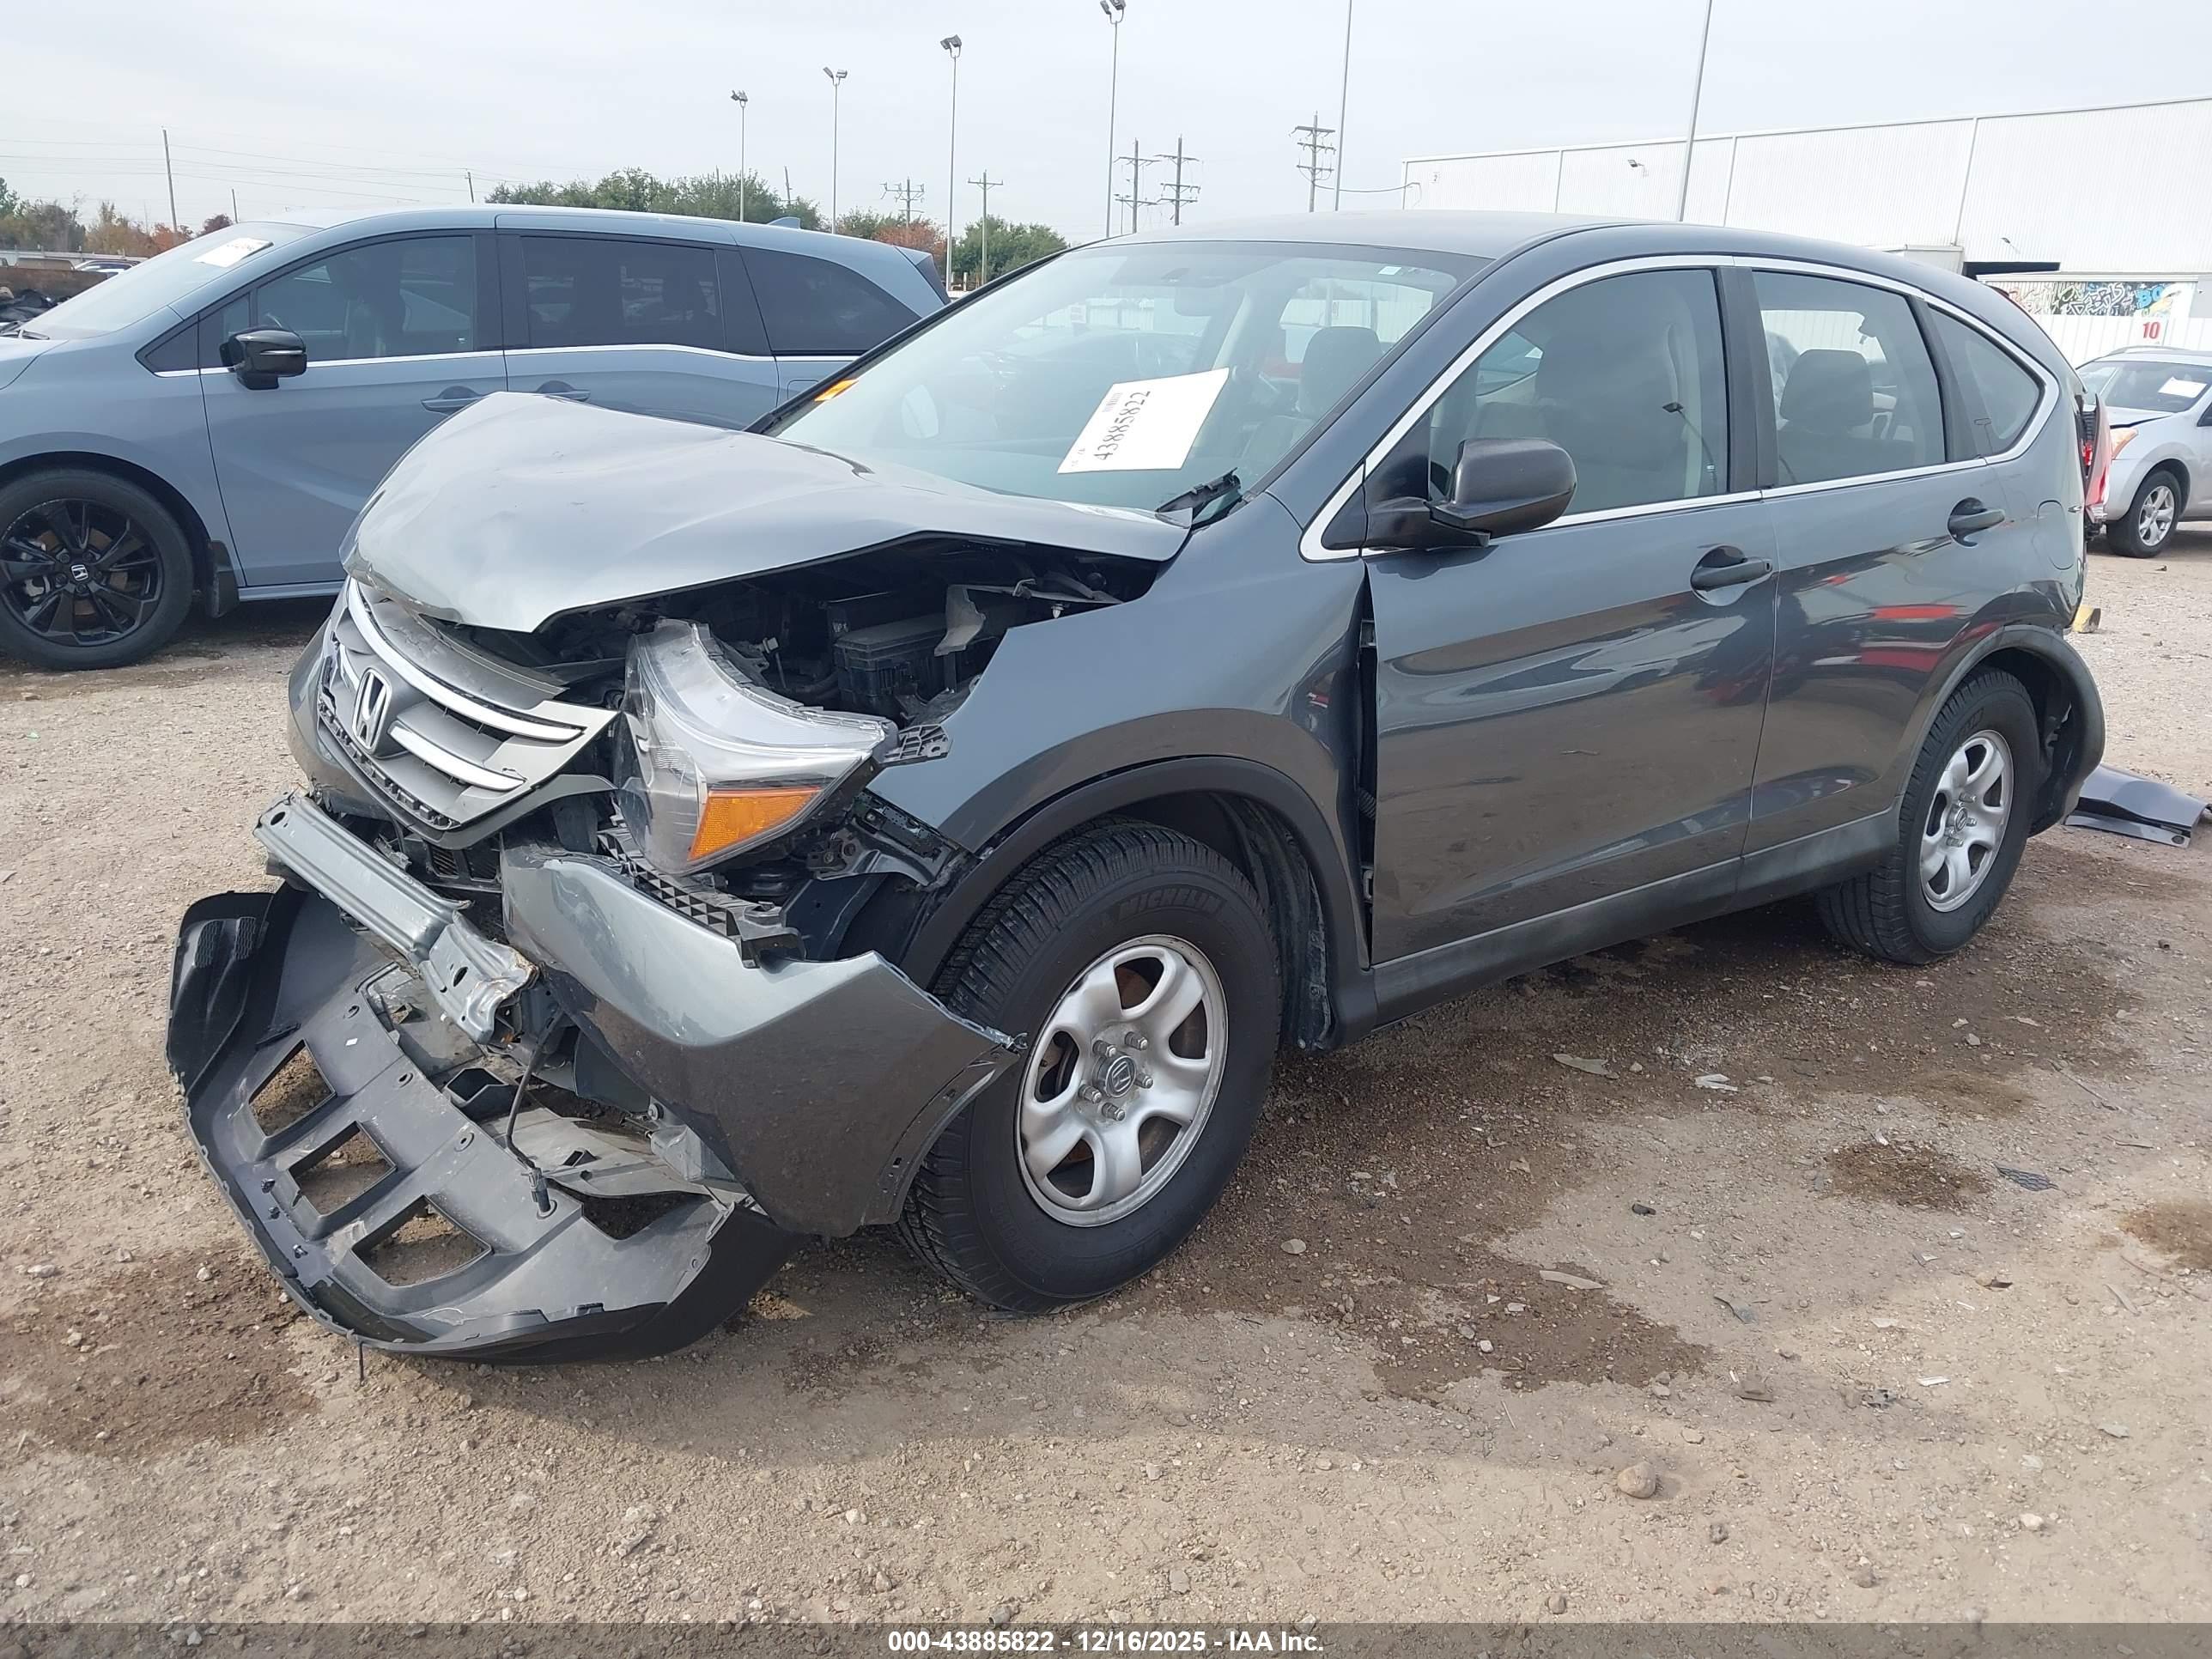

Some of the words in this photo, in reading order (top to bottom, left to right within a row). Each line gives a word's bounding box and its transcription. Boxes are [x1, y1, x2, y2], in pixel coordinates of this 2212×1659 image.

[2143, 321, 2160, 339] 10
[1093, 391, 1151, 460] 43885822
[1118, 886, 1224, 921] MICHELIN
